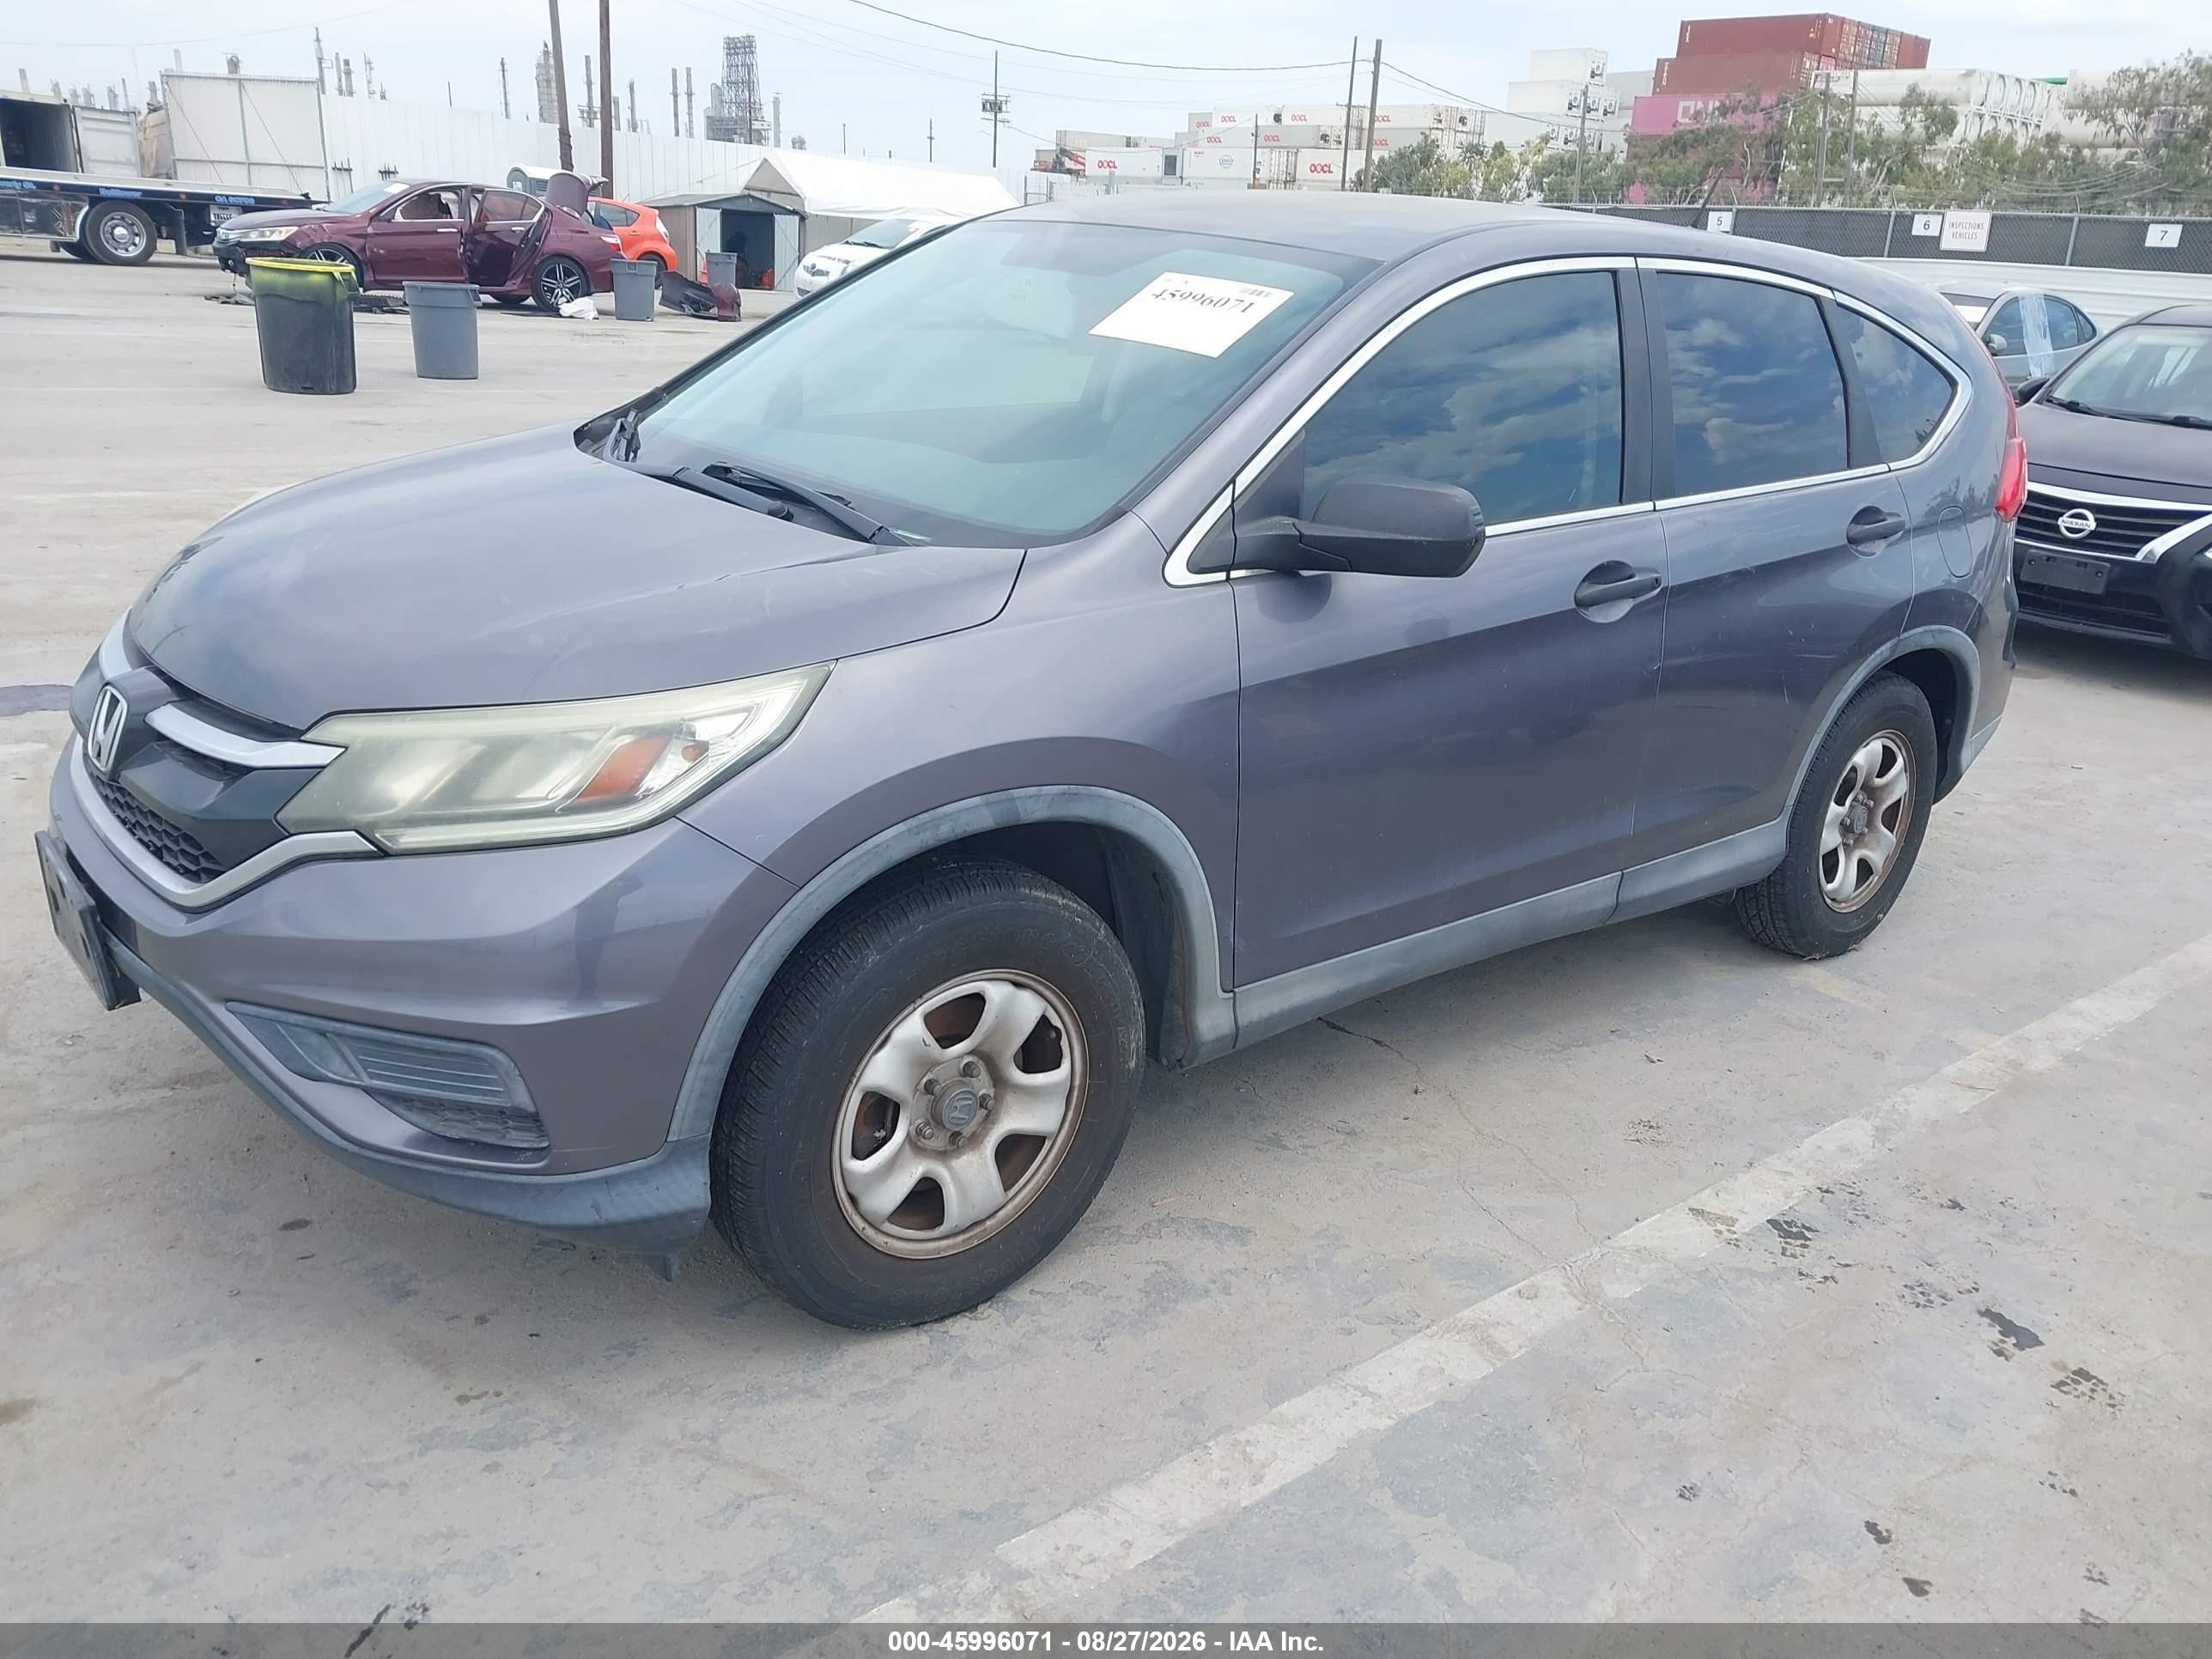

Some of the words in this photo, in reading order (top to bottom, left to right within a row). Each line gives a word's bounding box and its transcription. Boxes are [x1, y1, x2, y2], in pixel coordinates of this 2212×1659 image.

[1097, 159, 1117, 169] OOCL
[1310, 163, 1333, 174] OOCL
[1717, 216, 1723, 226] 5
[1923, 220, 1930, 230] 6
[1948, 221, 1984, 230] INSPECTIONS
[1951, 231, 1978, 240] VEHICLES
[2160, 229, 2168, 241] 7
[1151, 288, 1255, 313] 45996071
[2061, 519, 2091, 528] NISSAN
